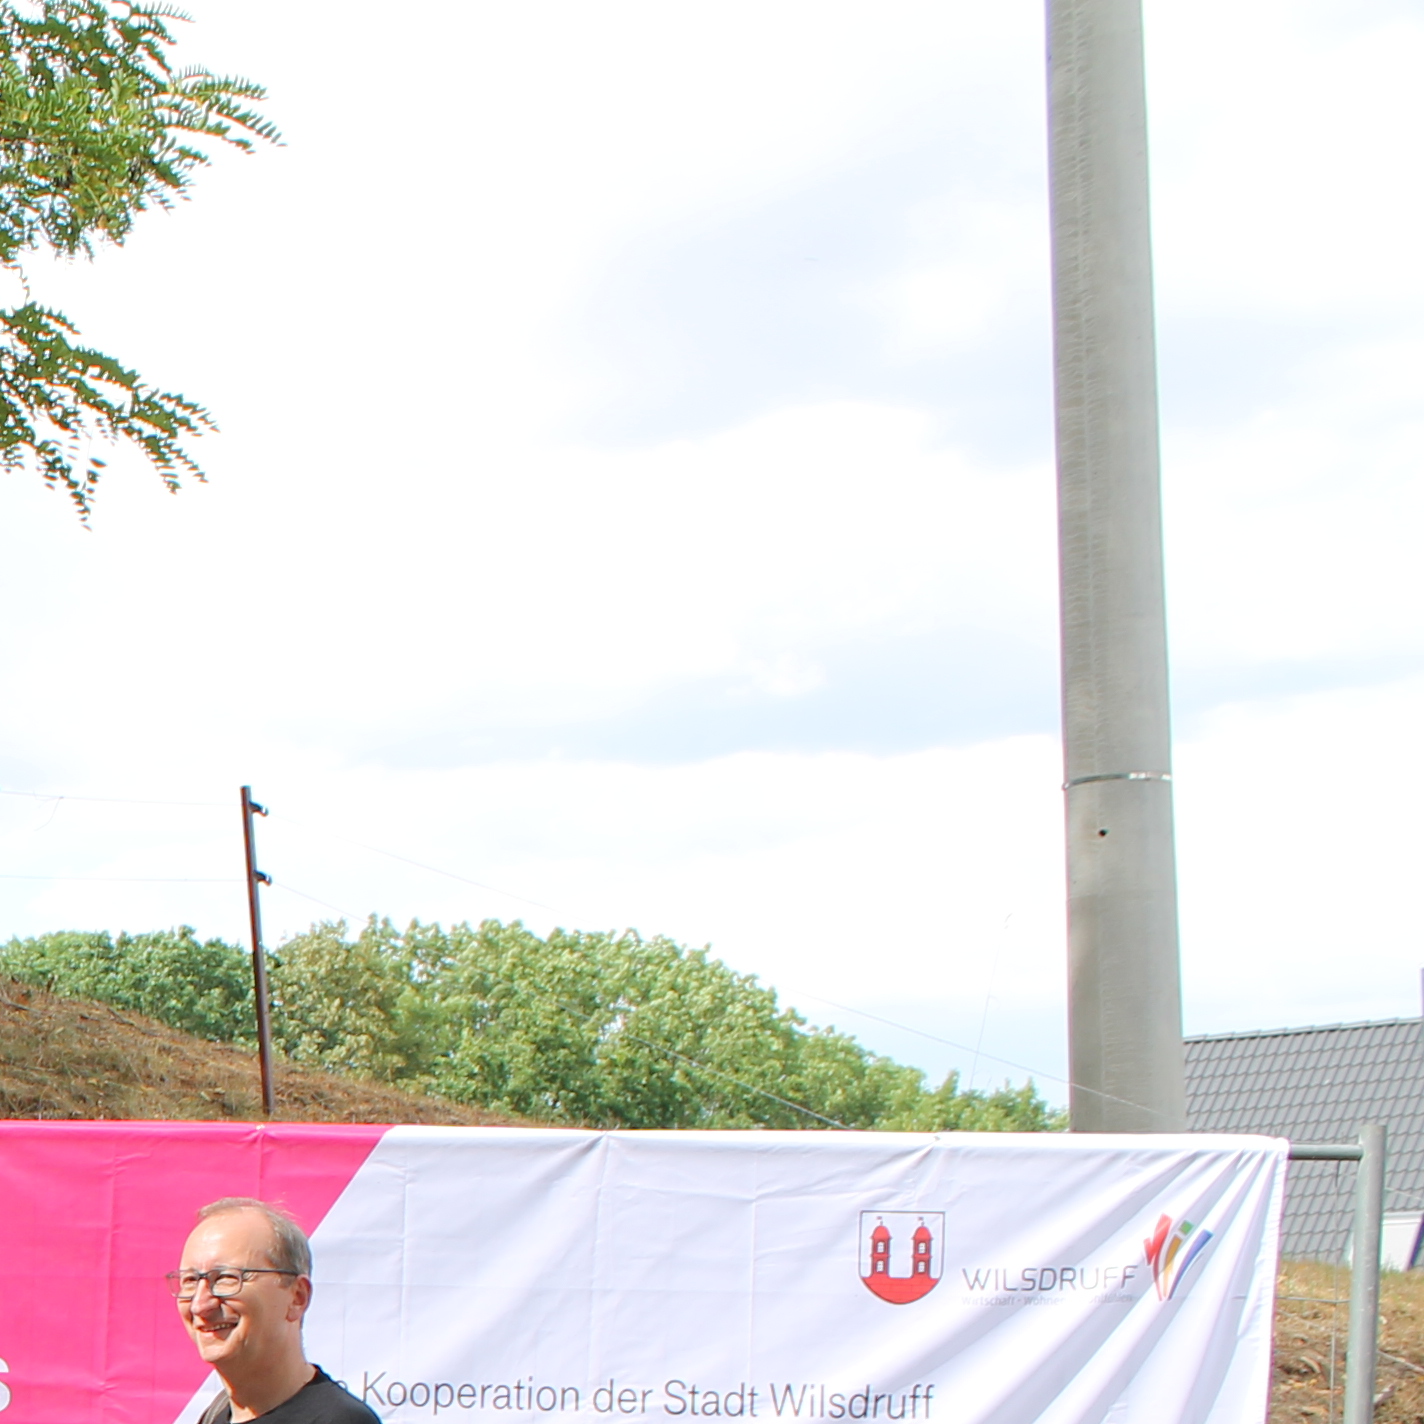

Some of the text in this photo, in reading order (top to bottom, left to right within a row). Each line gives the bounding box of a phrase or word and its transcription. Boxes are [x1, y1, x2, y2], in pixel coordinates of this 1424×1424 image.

[962, 1265, 1138, 1291] WILSDRUFF
[361, 1371, 936, 1420] Kooperation der Stadt Wilsdruff
